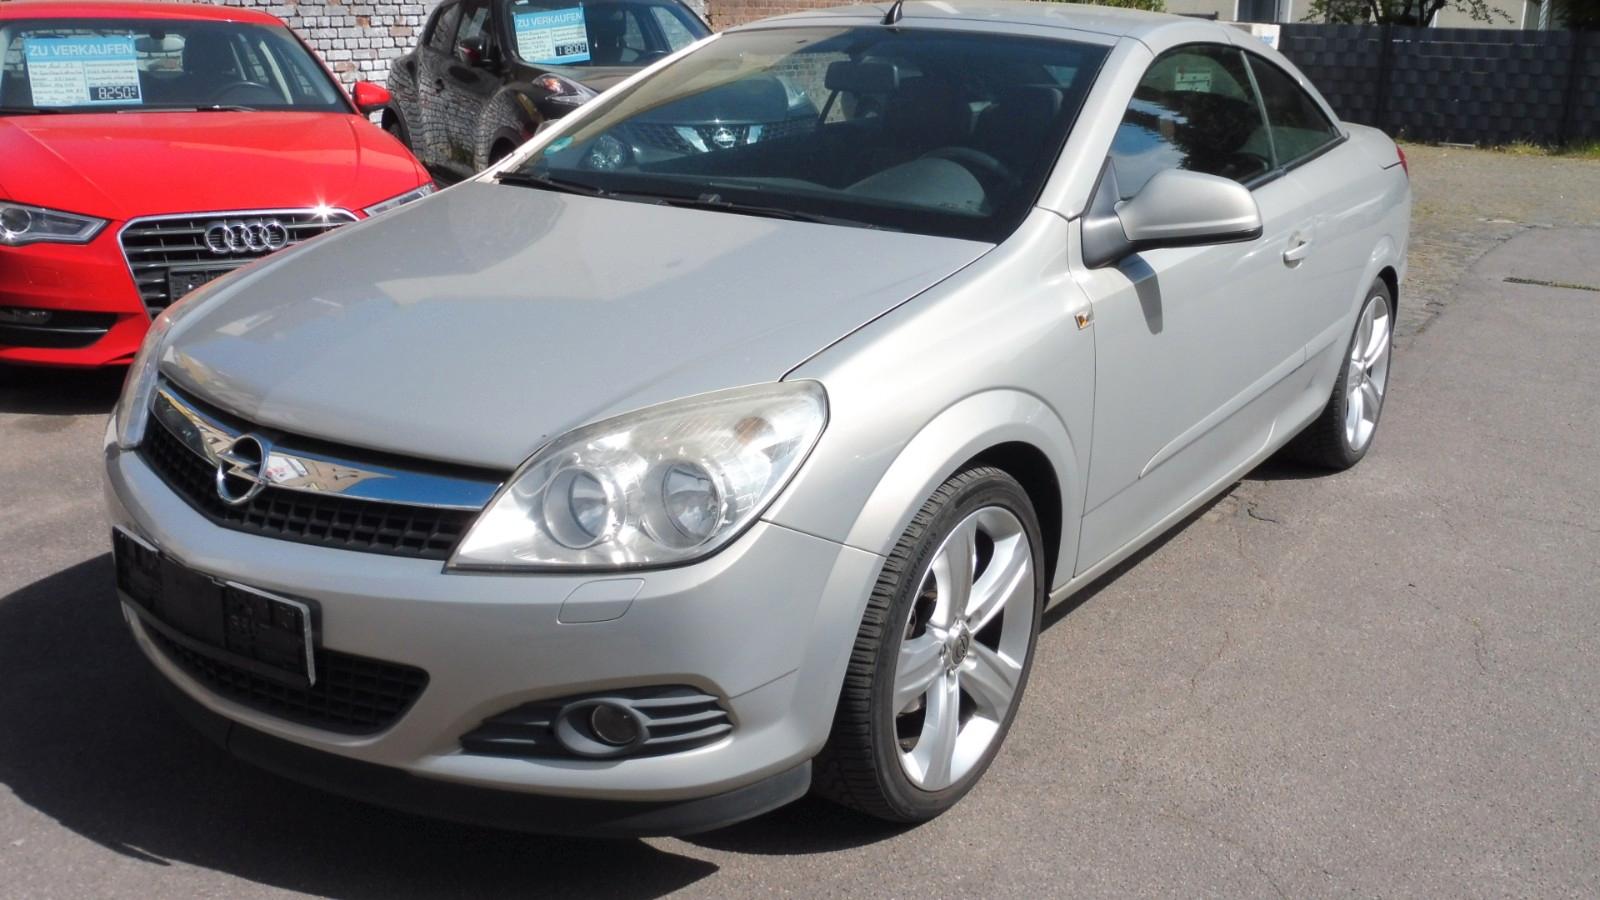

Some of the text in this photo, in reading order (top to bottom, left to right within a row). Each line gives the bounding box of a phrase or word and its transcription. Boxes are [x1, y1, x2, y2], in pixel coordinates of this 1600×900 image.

[517, 13, 583, 27] ZU VERKAUFEN
[30, 43, 133, 56] ZU VERKAUFEN
